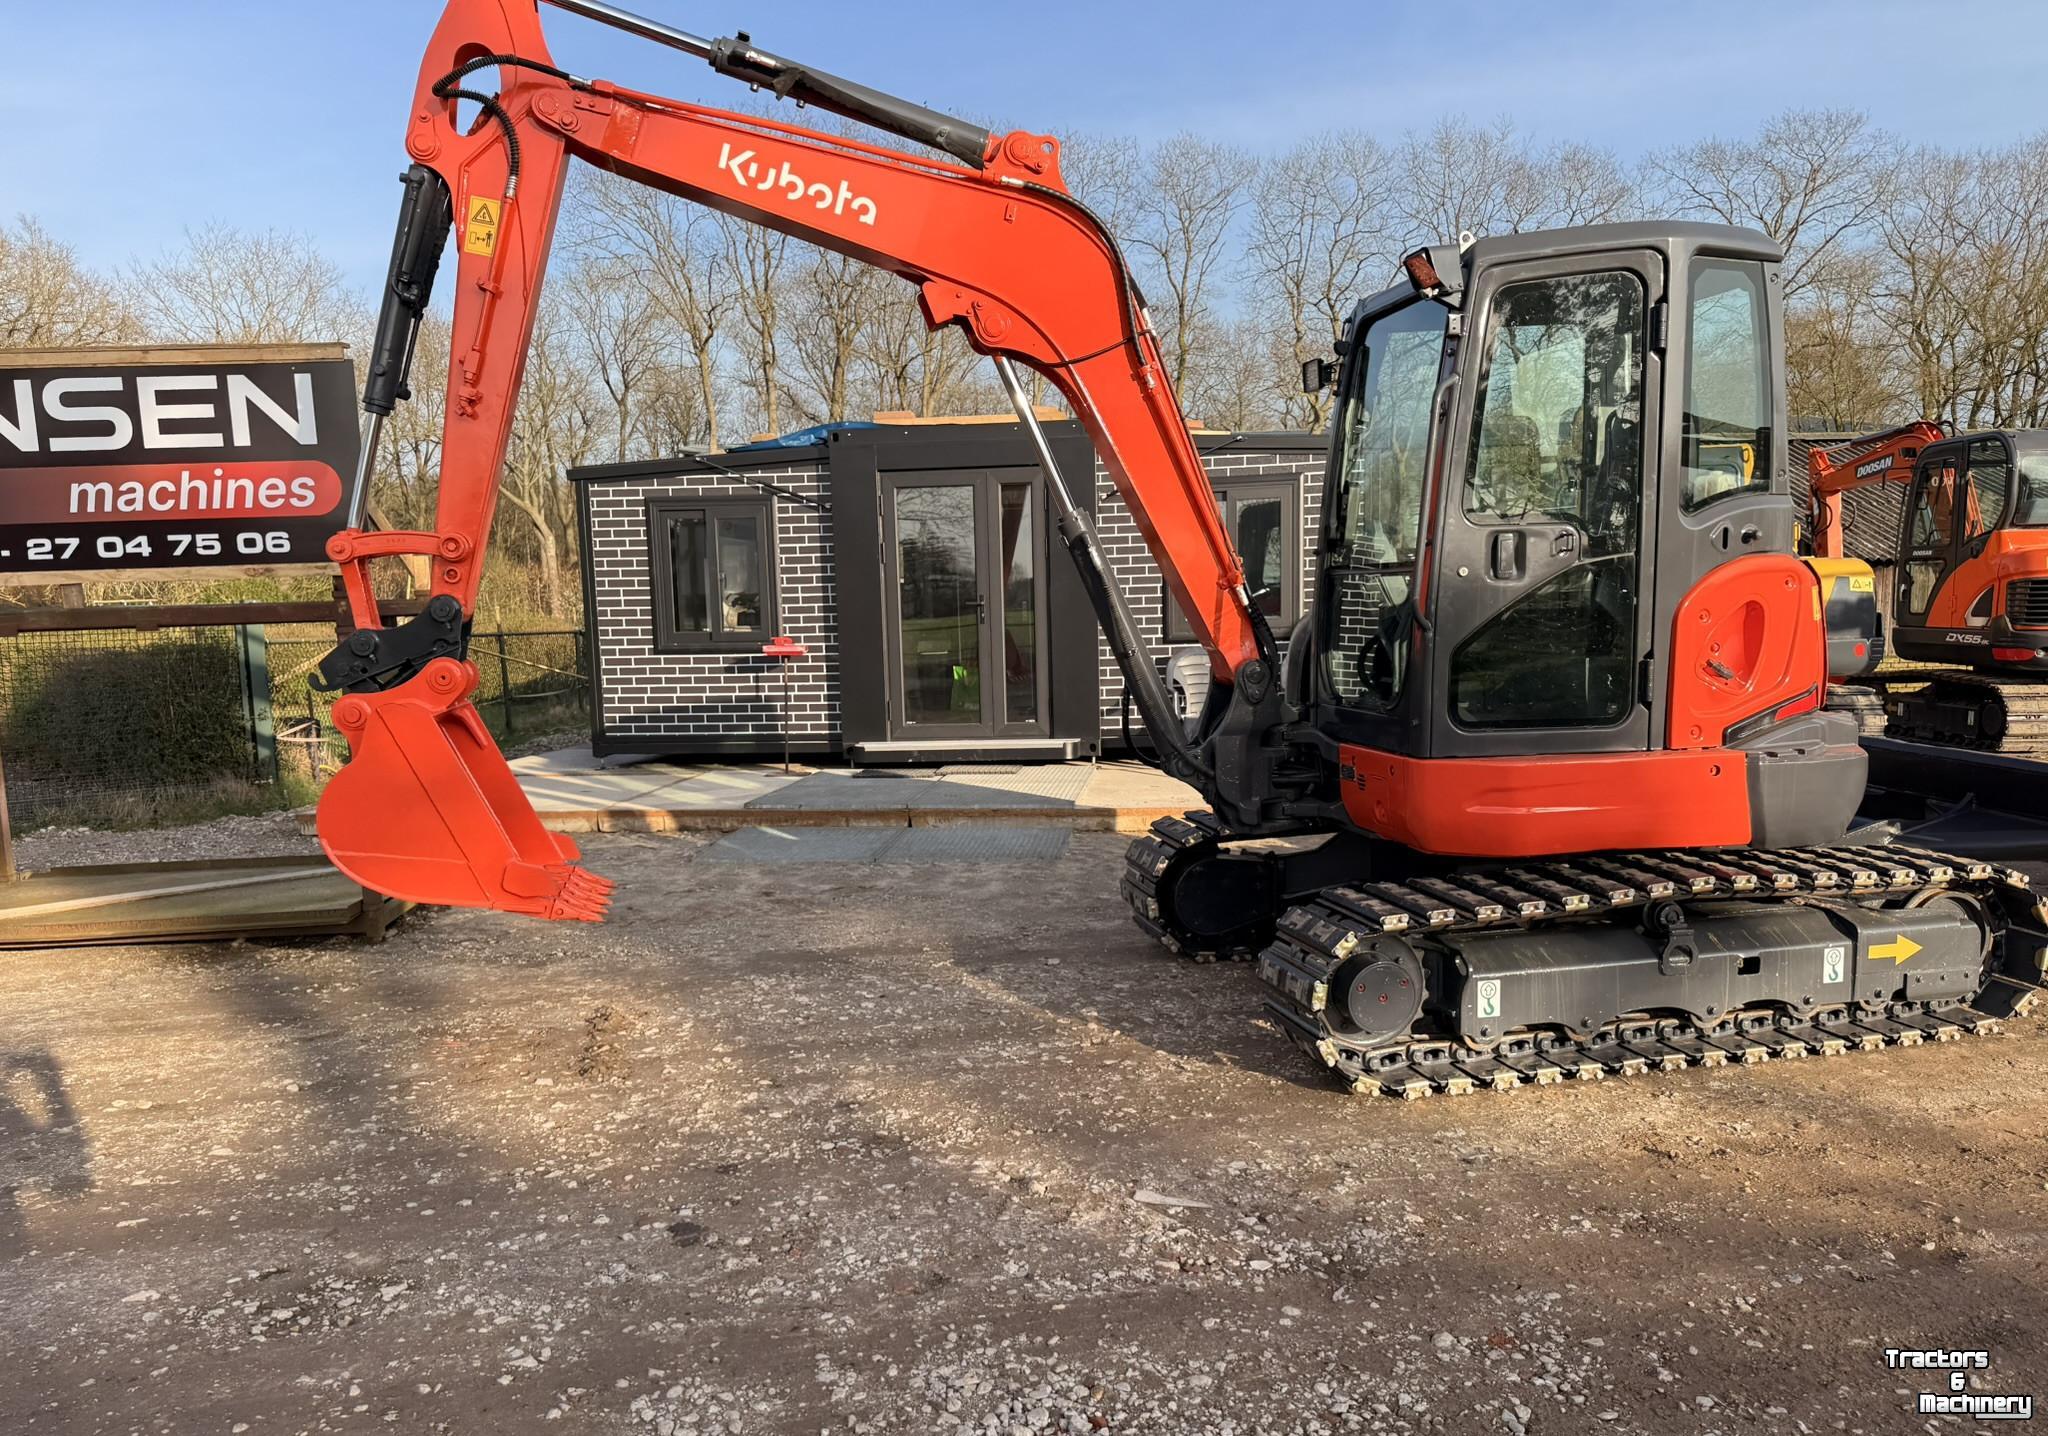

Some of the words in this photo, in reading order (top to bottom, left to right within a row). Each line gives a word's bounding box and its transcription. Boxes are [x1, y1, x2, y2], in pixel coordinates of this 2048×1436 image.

[718, 142, 877, 226] Kubota
[1856, 455, 1893, 478] DOOSAN
[69, 468, 316, 513] machines
[26, 538, 80, 560] 27
[96, 535, 152, 558] 04
[167, 533, 222, 556] 75
[236, 531, 291, 554] 06
